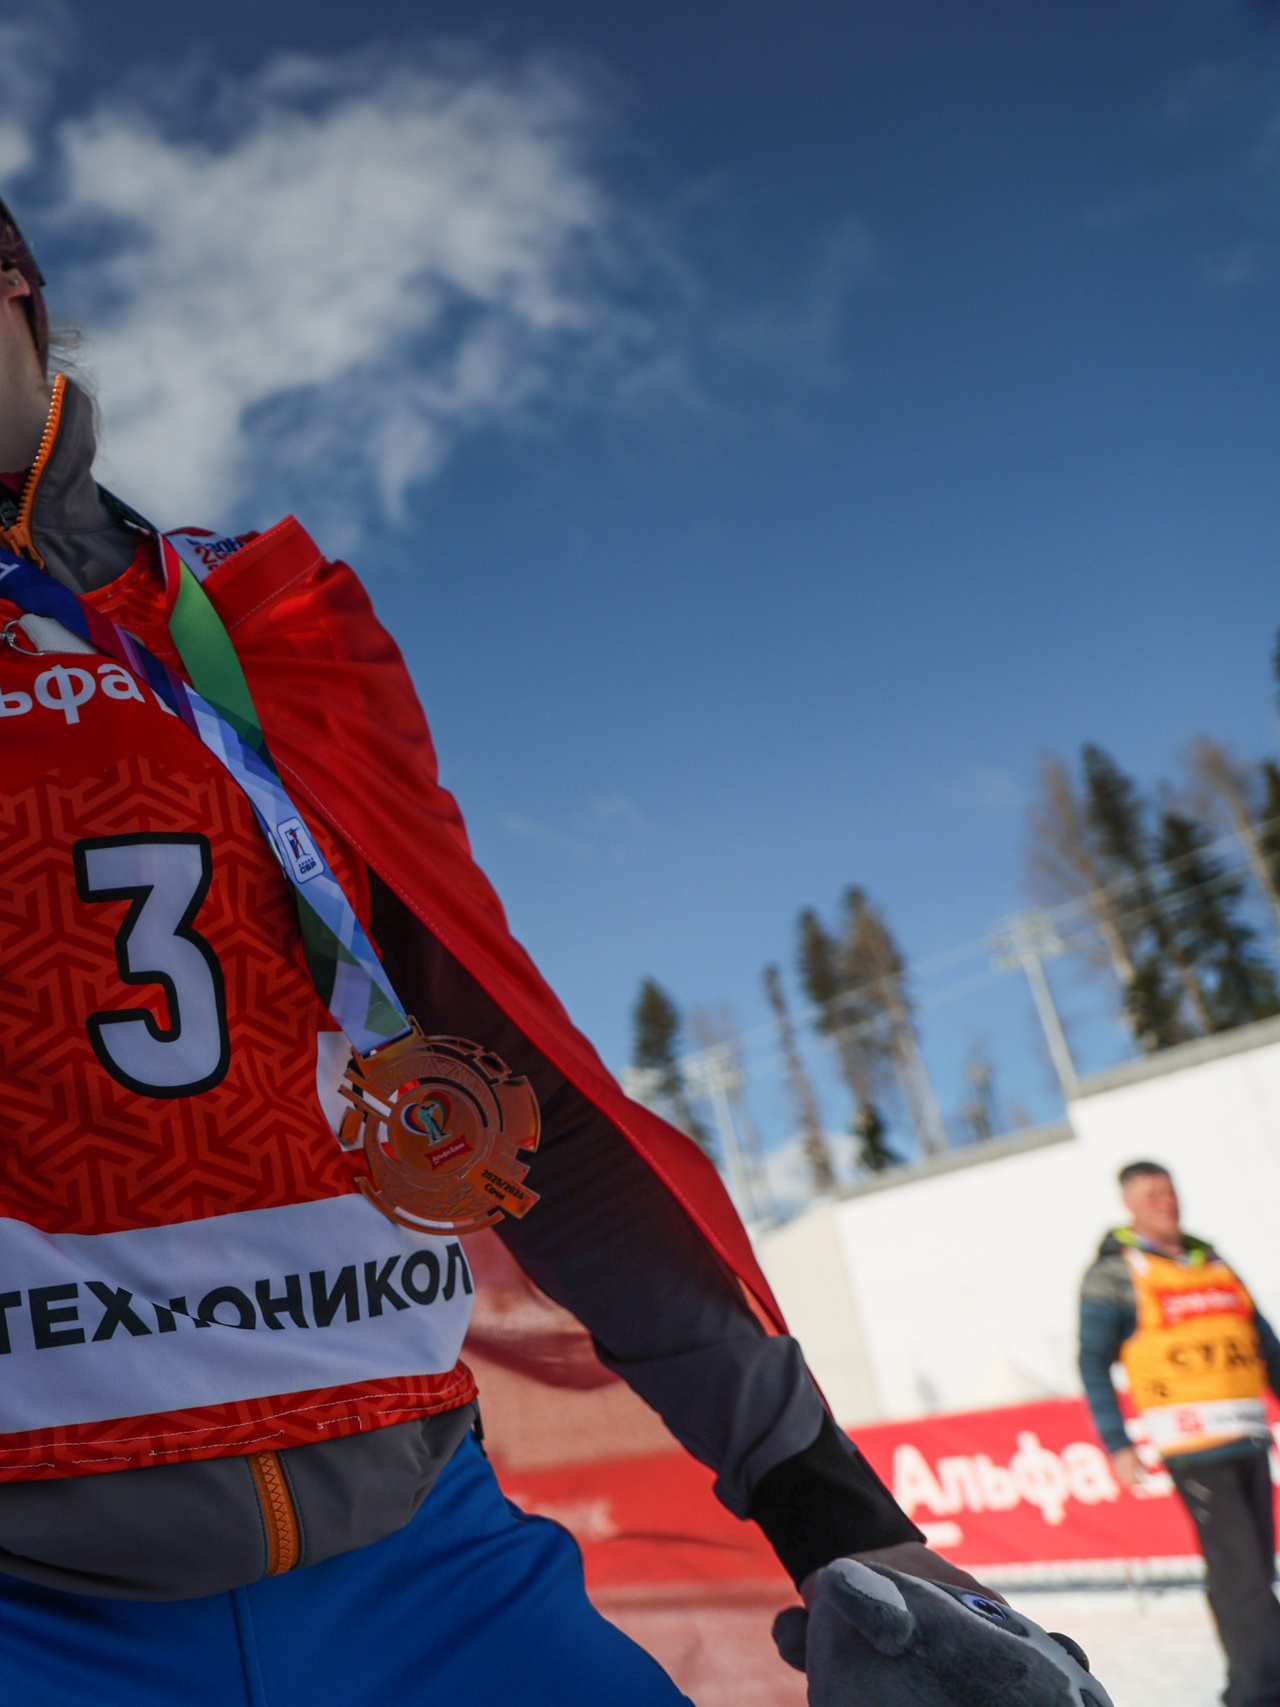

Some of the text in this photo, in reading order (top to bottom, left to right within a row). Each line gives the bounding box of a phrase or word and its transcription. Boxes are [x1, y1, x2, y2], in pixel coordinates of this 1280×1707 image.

[72, 832, 231, 1099] 3
[481, 1169, 524, 1200] 2025/2026
[484, 1183, 506, 1201] Сочи
[892, 1430, 1116, 1526] Альфа
